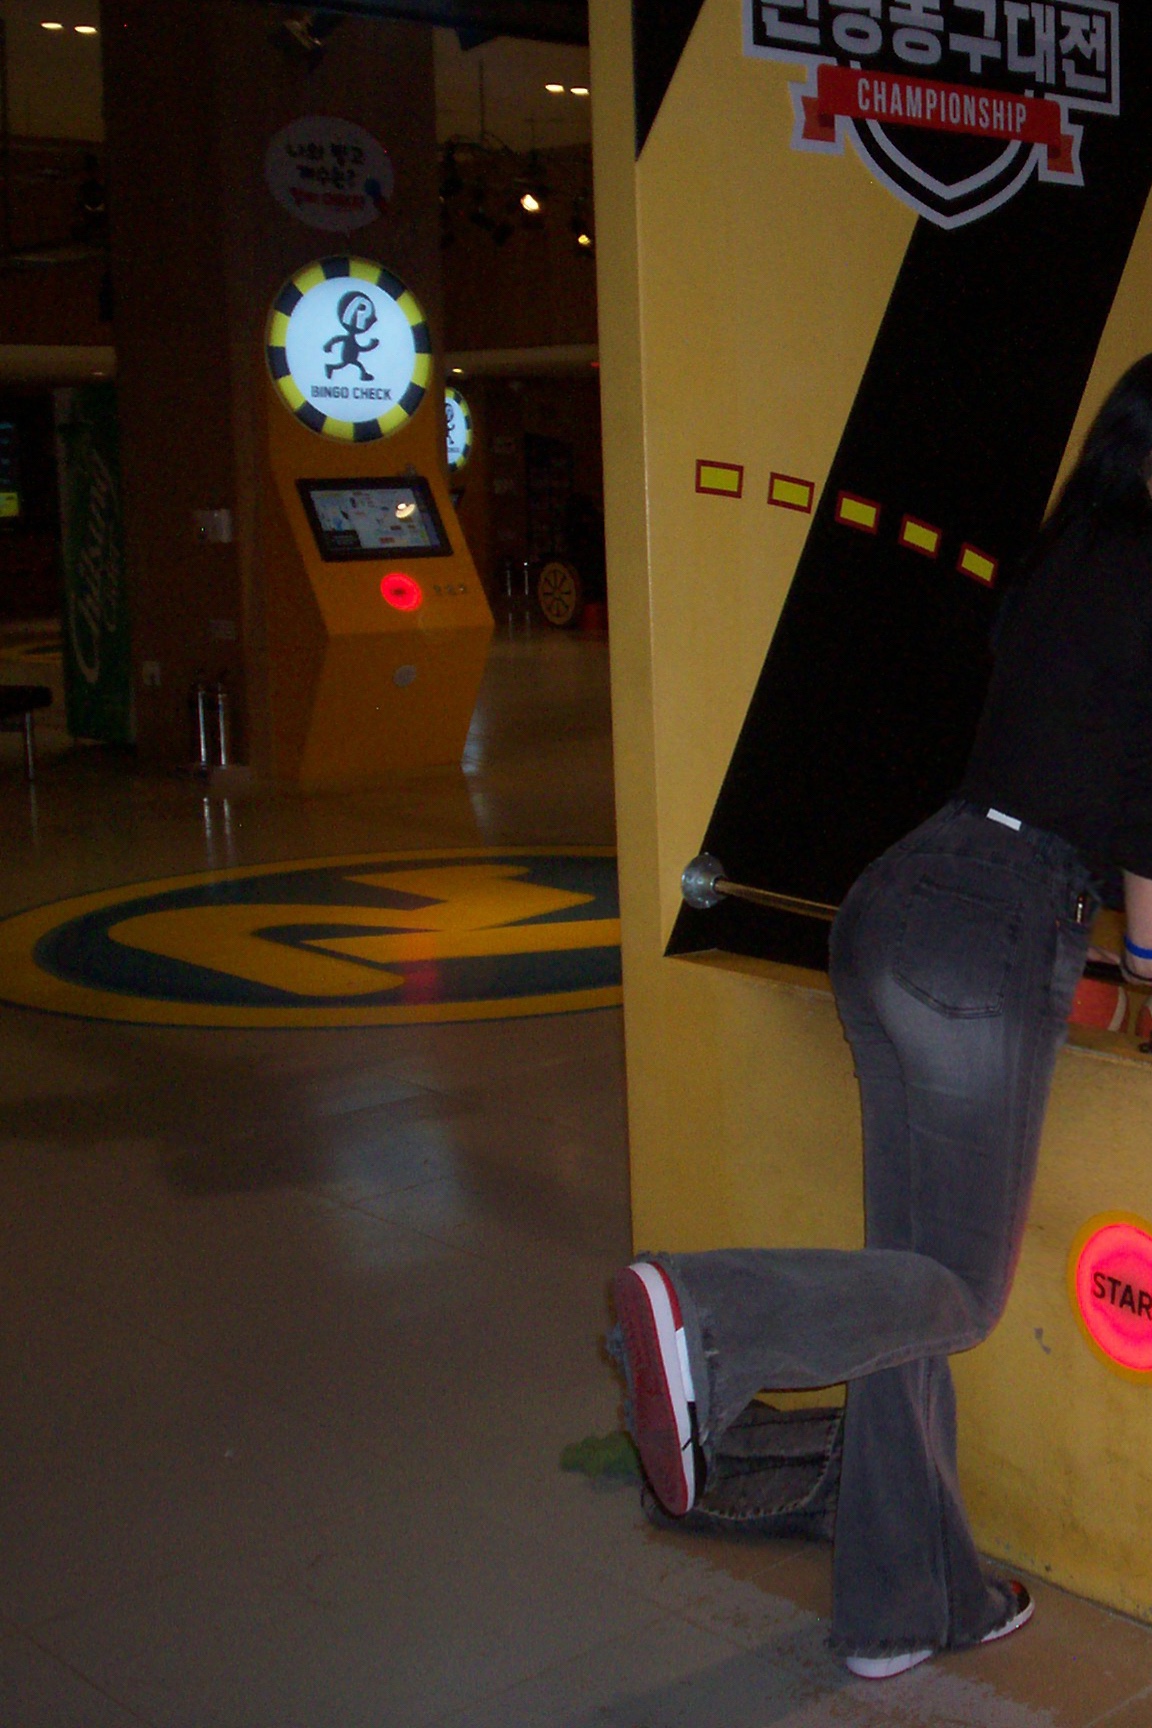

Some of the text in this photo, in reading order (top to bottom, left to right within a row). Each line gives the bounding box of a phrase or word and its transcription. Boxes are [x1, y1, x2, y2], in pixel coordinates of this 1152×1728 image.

[857, 77, 1027, 133] CHAMPIONSHIP
[311, 385, 391, 400] BINGO CHECK
